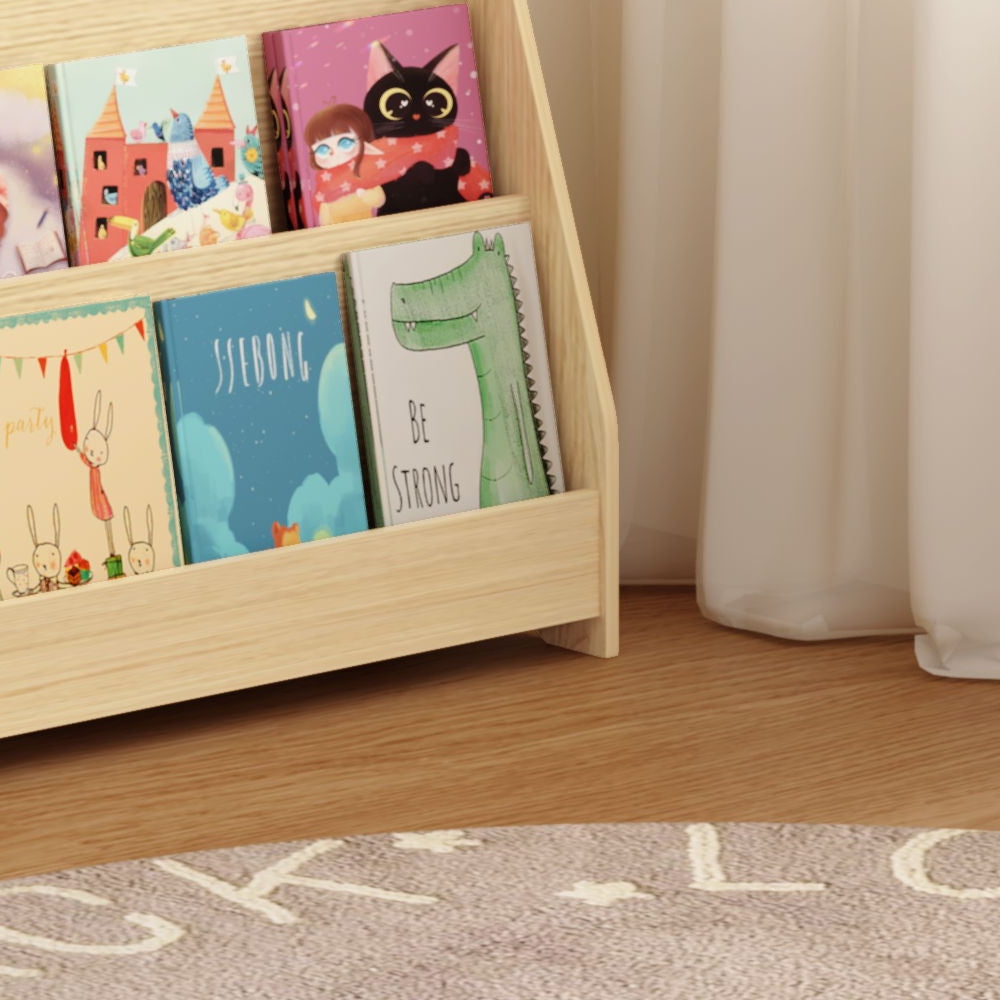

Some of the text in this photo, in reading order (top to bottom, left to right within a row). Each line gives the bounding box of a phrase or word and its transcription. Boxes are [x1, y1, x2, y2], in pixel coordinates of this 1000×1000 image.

[5, 407, 56, 449] party
[409, 400, 430, 444] BE
[392, 462, 460, 513] STRONG
